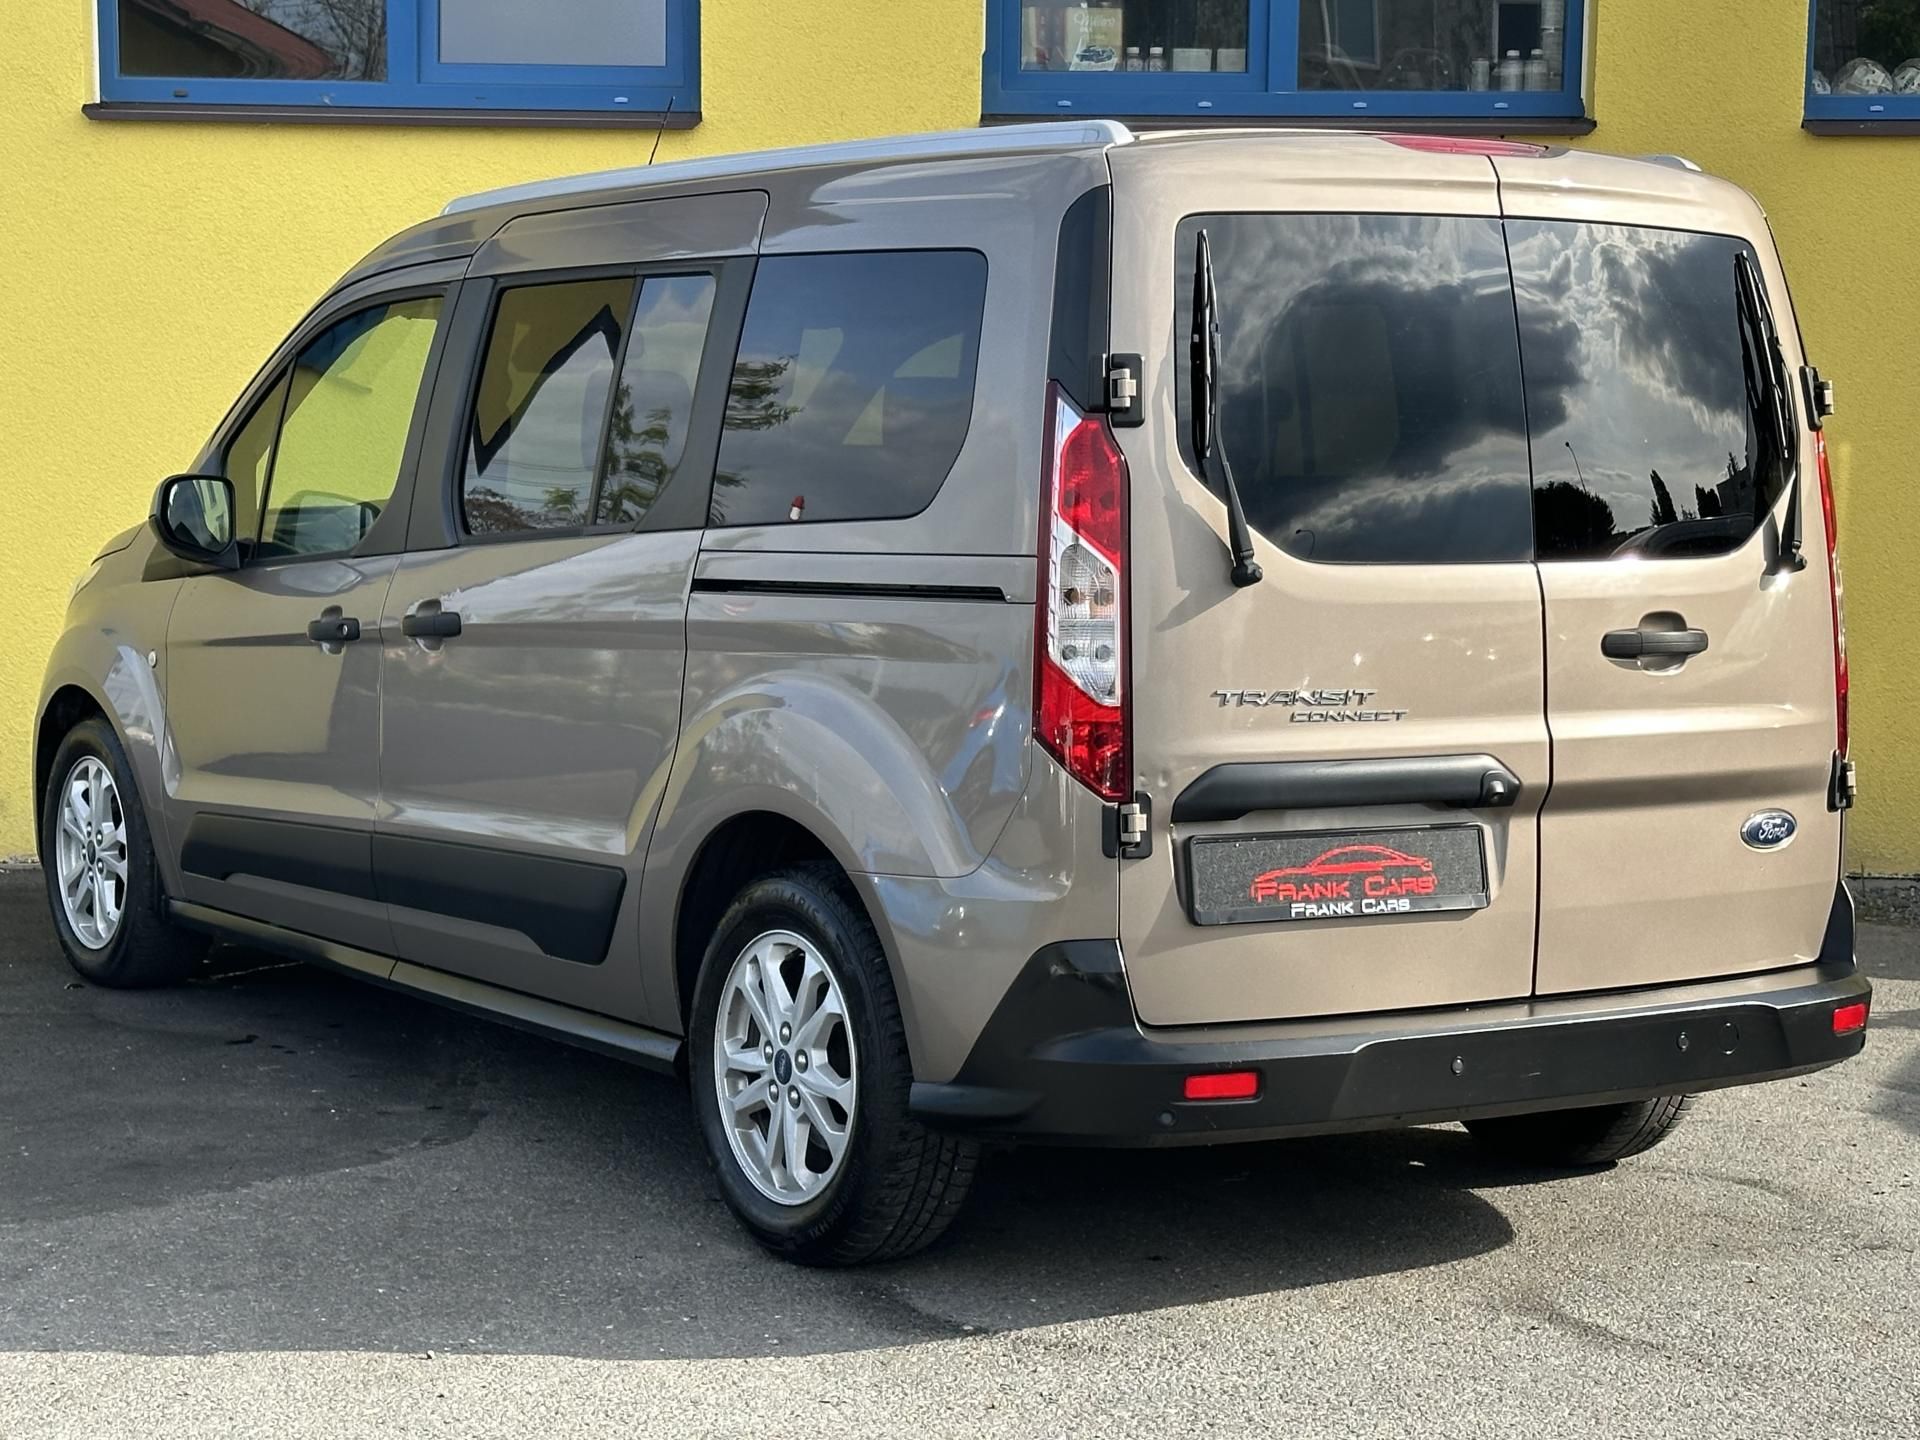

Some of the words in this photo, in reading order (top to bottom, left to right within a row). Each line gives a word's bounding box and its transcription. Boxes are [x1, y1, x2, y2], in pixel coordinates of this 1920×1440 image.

[1210, 688, 1378, 707] TRANSIT
[1289, 709, 1409, 723] CONNECT
[1758, 817, 1788, 840] Ford
[1256, 879, 1350, 903] FRANK
[1364, 874, 1434, 897] CARS
[1290, 901, 1354, 918] FRANK
[1361, 898, 1410, 914] CARS
